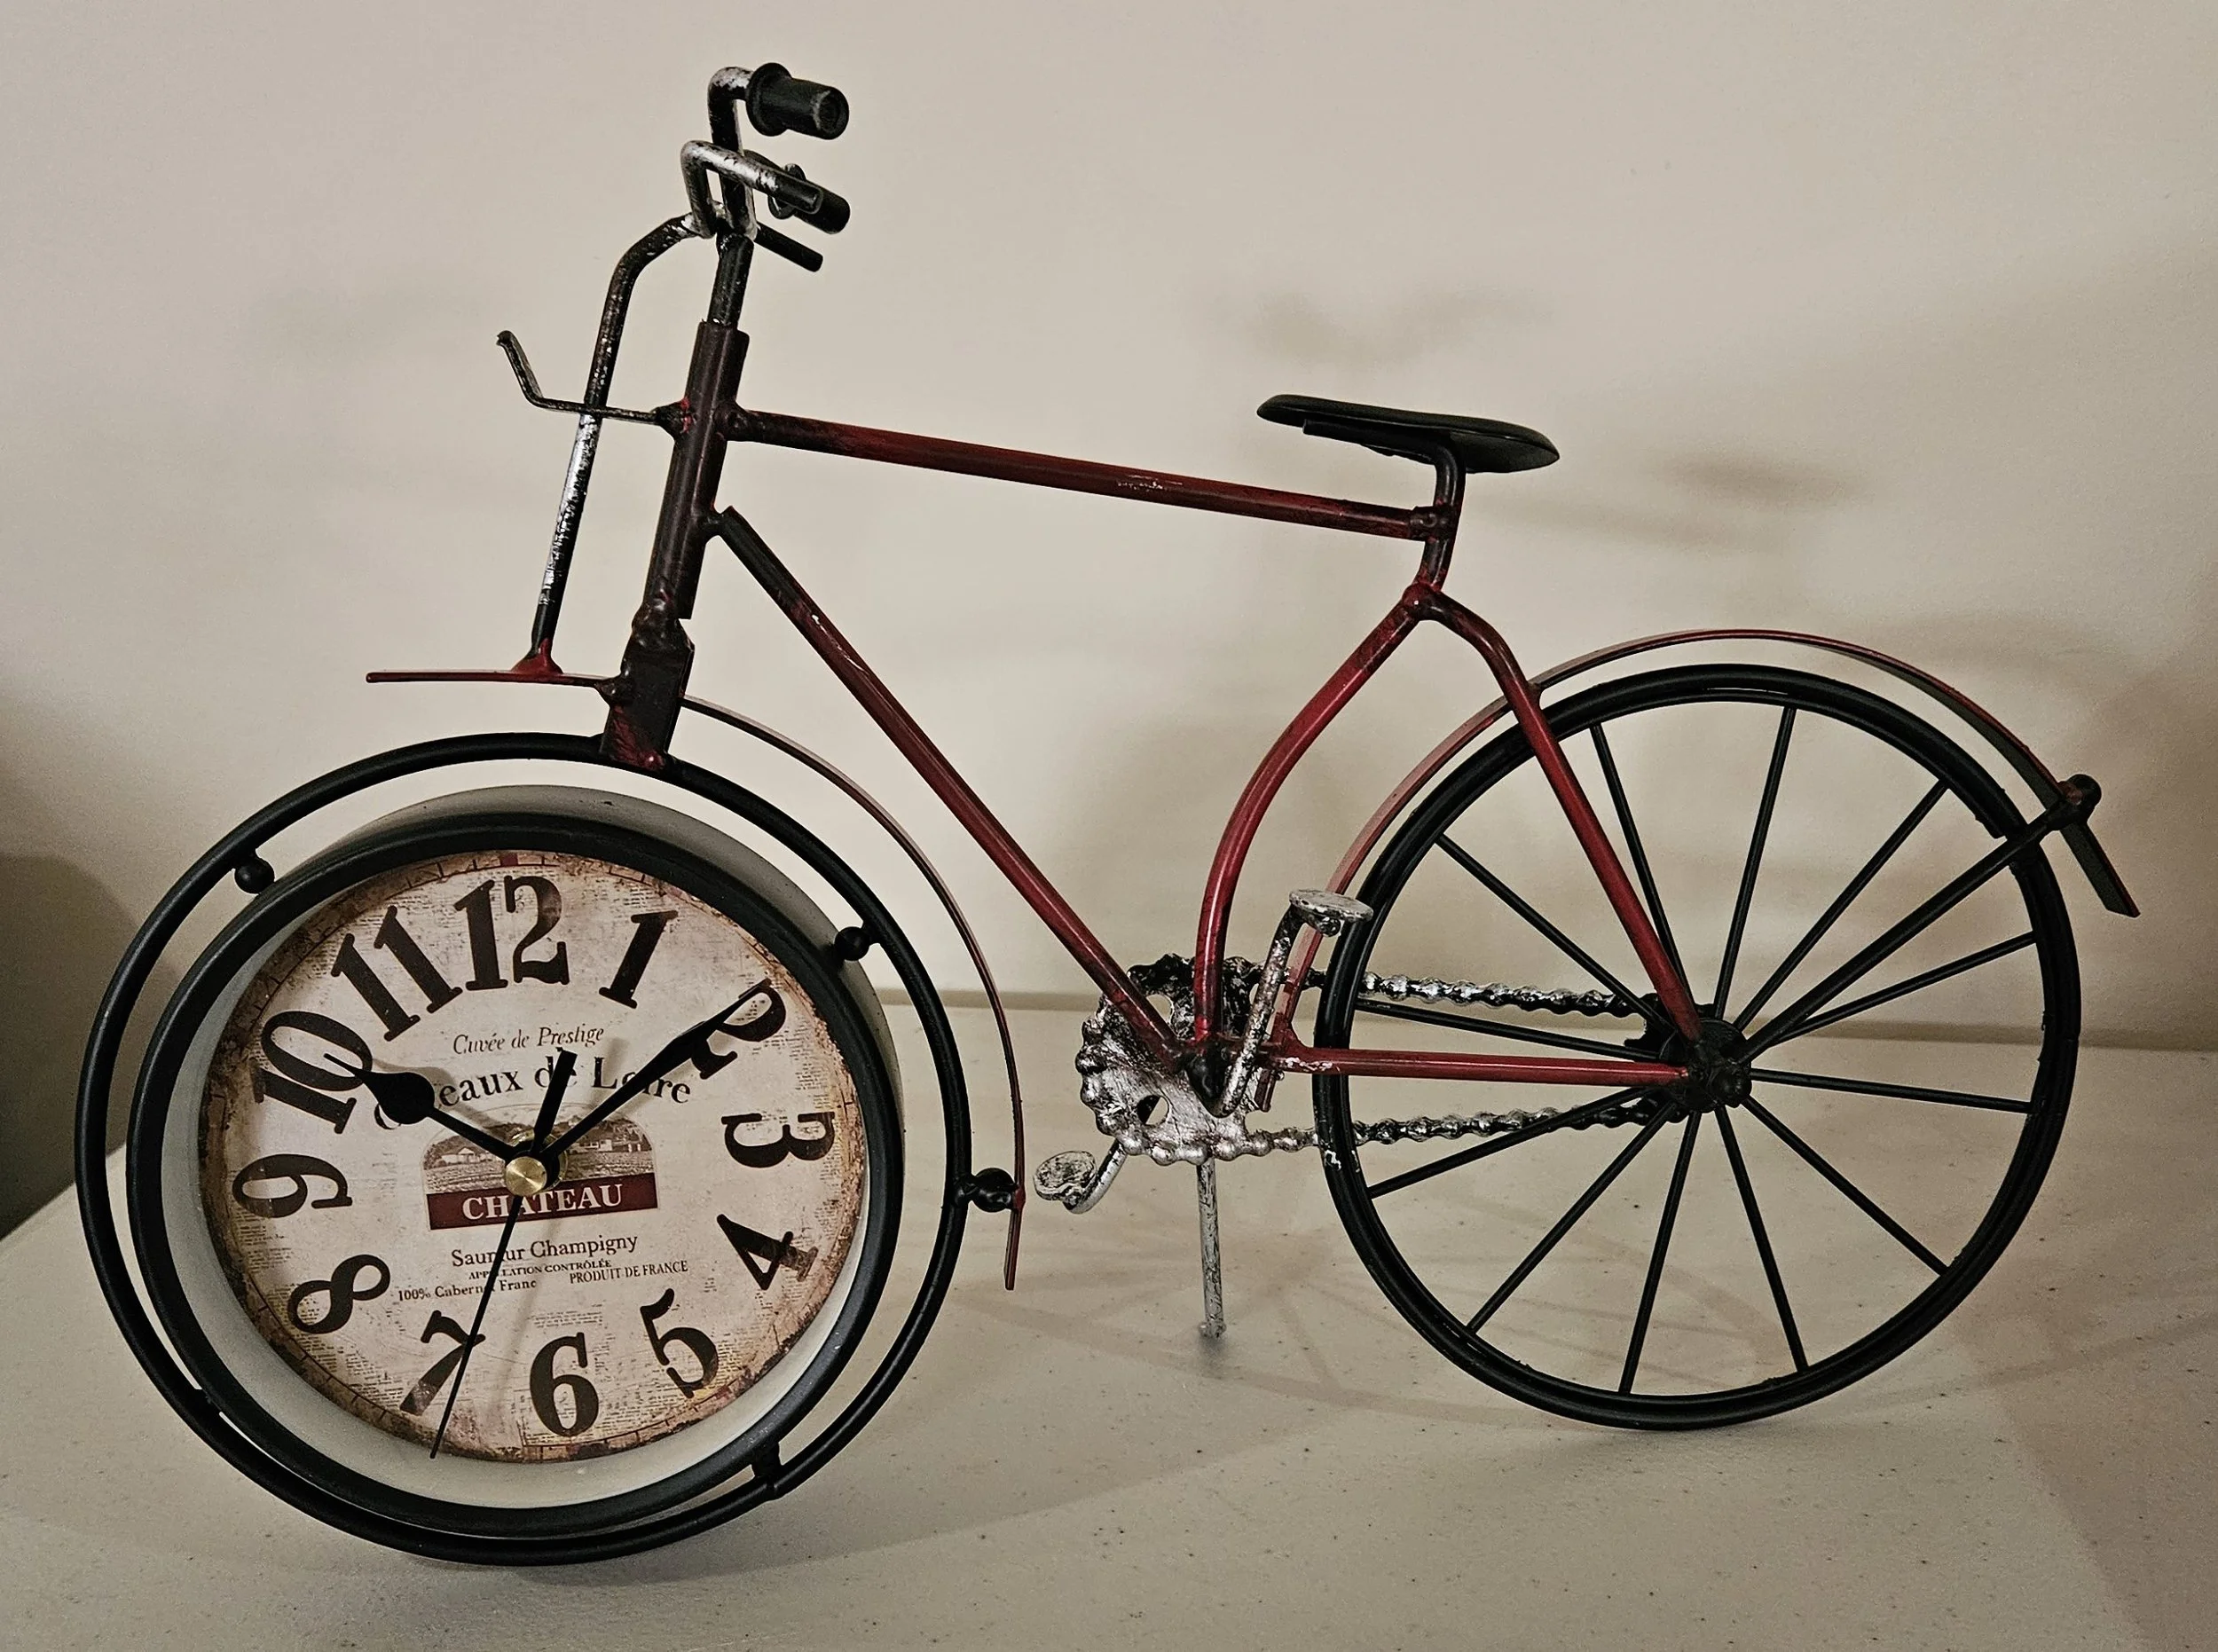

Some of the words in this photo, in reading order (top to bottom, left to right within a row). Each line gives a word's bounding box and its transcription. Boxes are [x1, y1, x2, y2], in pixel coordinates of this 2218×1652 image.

[332, 904, 463, 1042] 11
[454, 875, 570, 992] 12
[599, 909, 678, 1009] 1
[453, 1032, 505, 1055] Cuvée
[511, 1028, 530, 1049] de
[537, 1023, 604, 1048] Prestige
[690, 978, 786, 1080] 2
[249, 1011, 373, 1134] 10
[592, 1056, 690, 1104] Lre
[722, 1111, 835, 1169] 3
[232, 1153, 353, 1218] 9
[468, 1265, 542, 1280] APPLATION
[530, 1234, 638, 1259] Champigny
[570, 1267, 622, 1284] PRODUIT
[625, 1265, 641, 1278] DE
[643, 1260, 688, 1276] FRANCE
[717, 1212, 819, 1291] 4
[287, 1254, 390, 1334] 8
[398, 1287, 431, 1302] 100%
[434, 1283, 495, 1298] Cabern
[499, 1279, 537, 1292] Franc
[399, 1310, 486, 1416] 7
[640, 1288, 719, 1398] 5
[531, 1333, 600, 1437] 6
